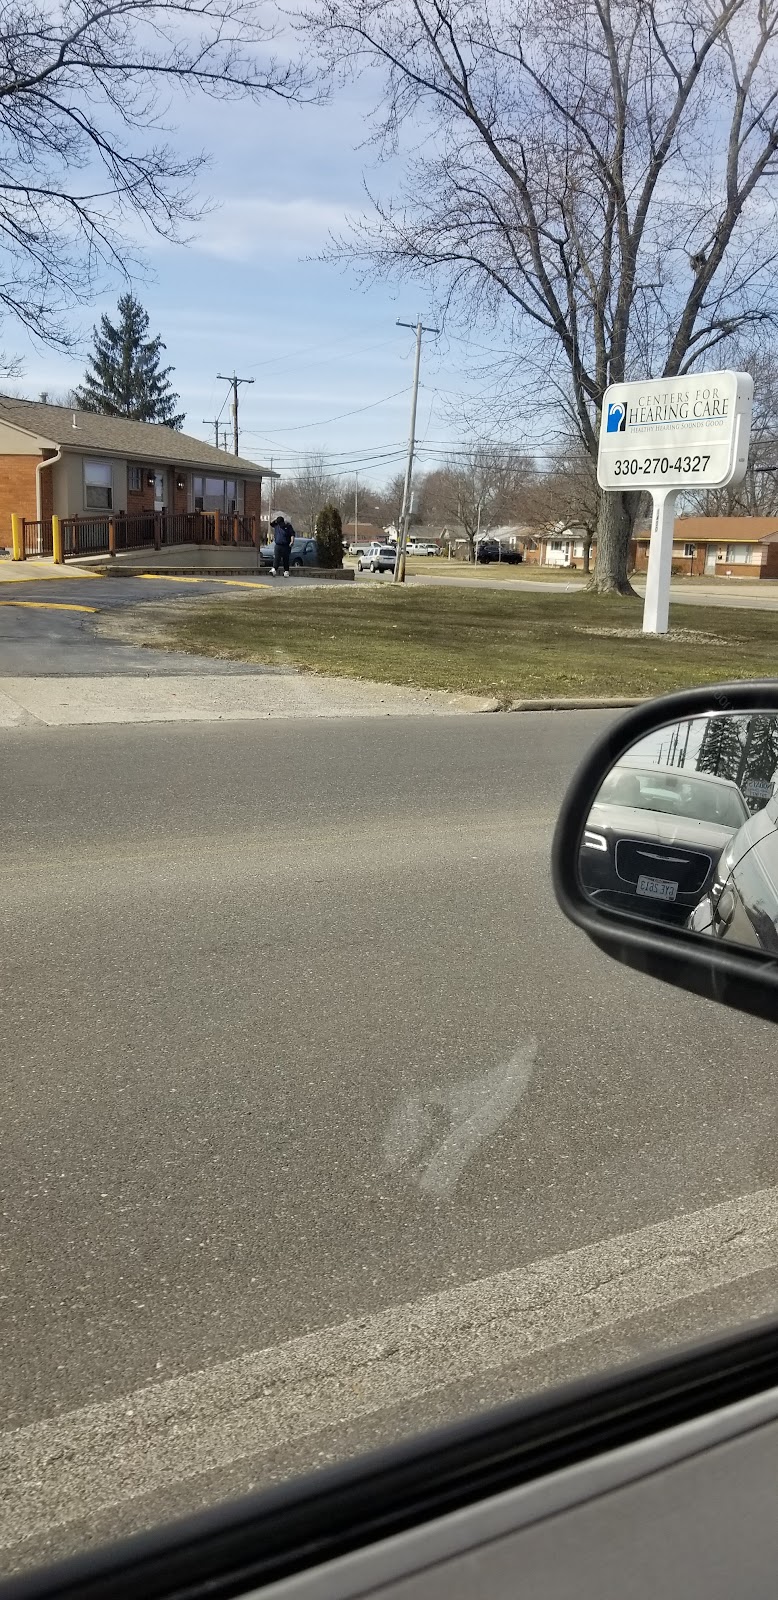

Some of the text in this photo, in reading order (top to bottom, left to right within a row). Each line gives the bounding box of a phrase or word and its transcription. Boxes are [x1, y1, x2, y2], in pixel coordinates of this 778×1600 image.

[638, 388, 720, 406] CENTERS FOR
[629, 398, 729, 423] HEARING CARE
[655, 423, 680, 432] HEARING
[705, 419, 724, 428] GOOD
[614, 455, 711, 476] 330-270-4327
